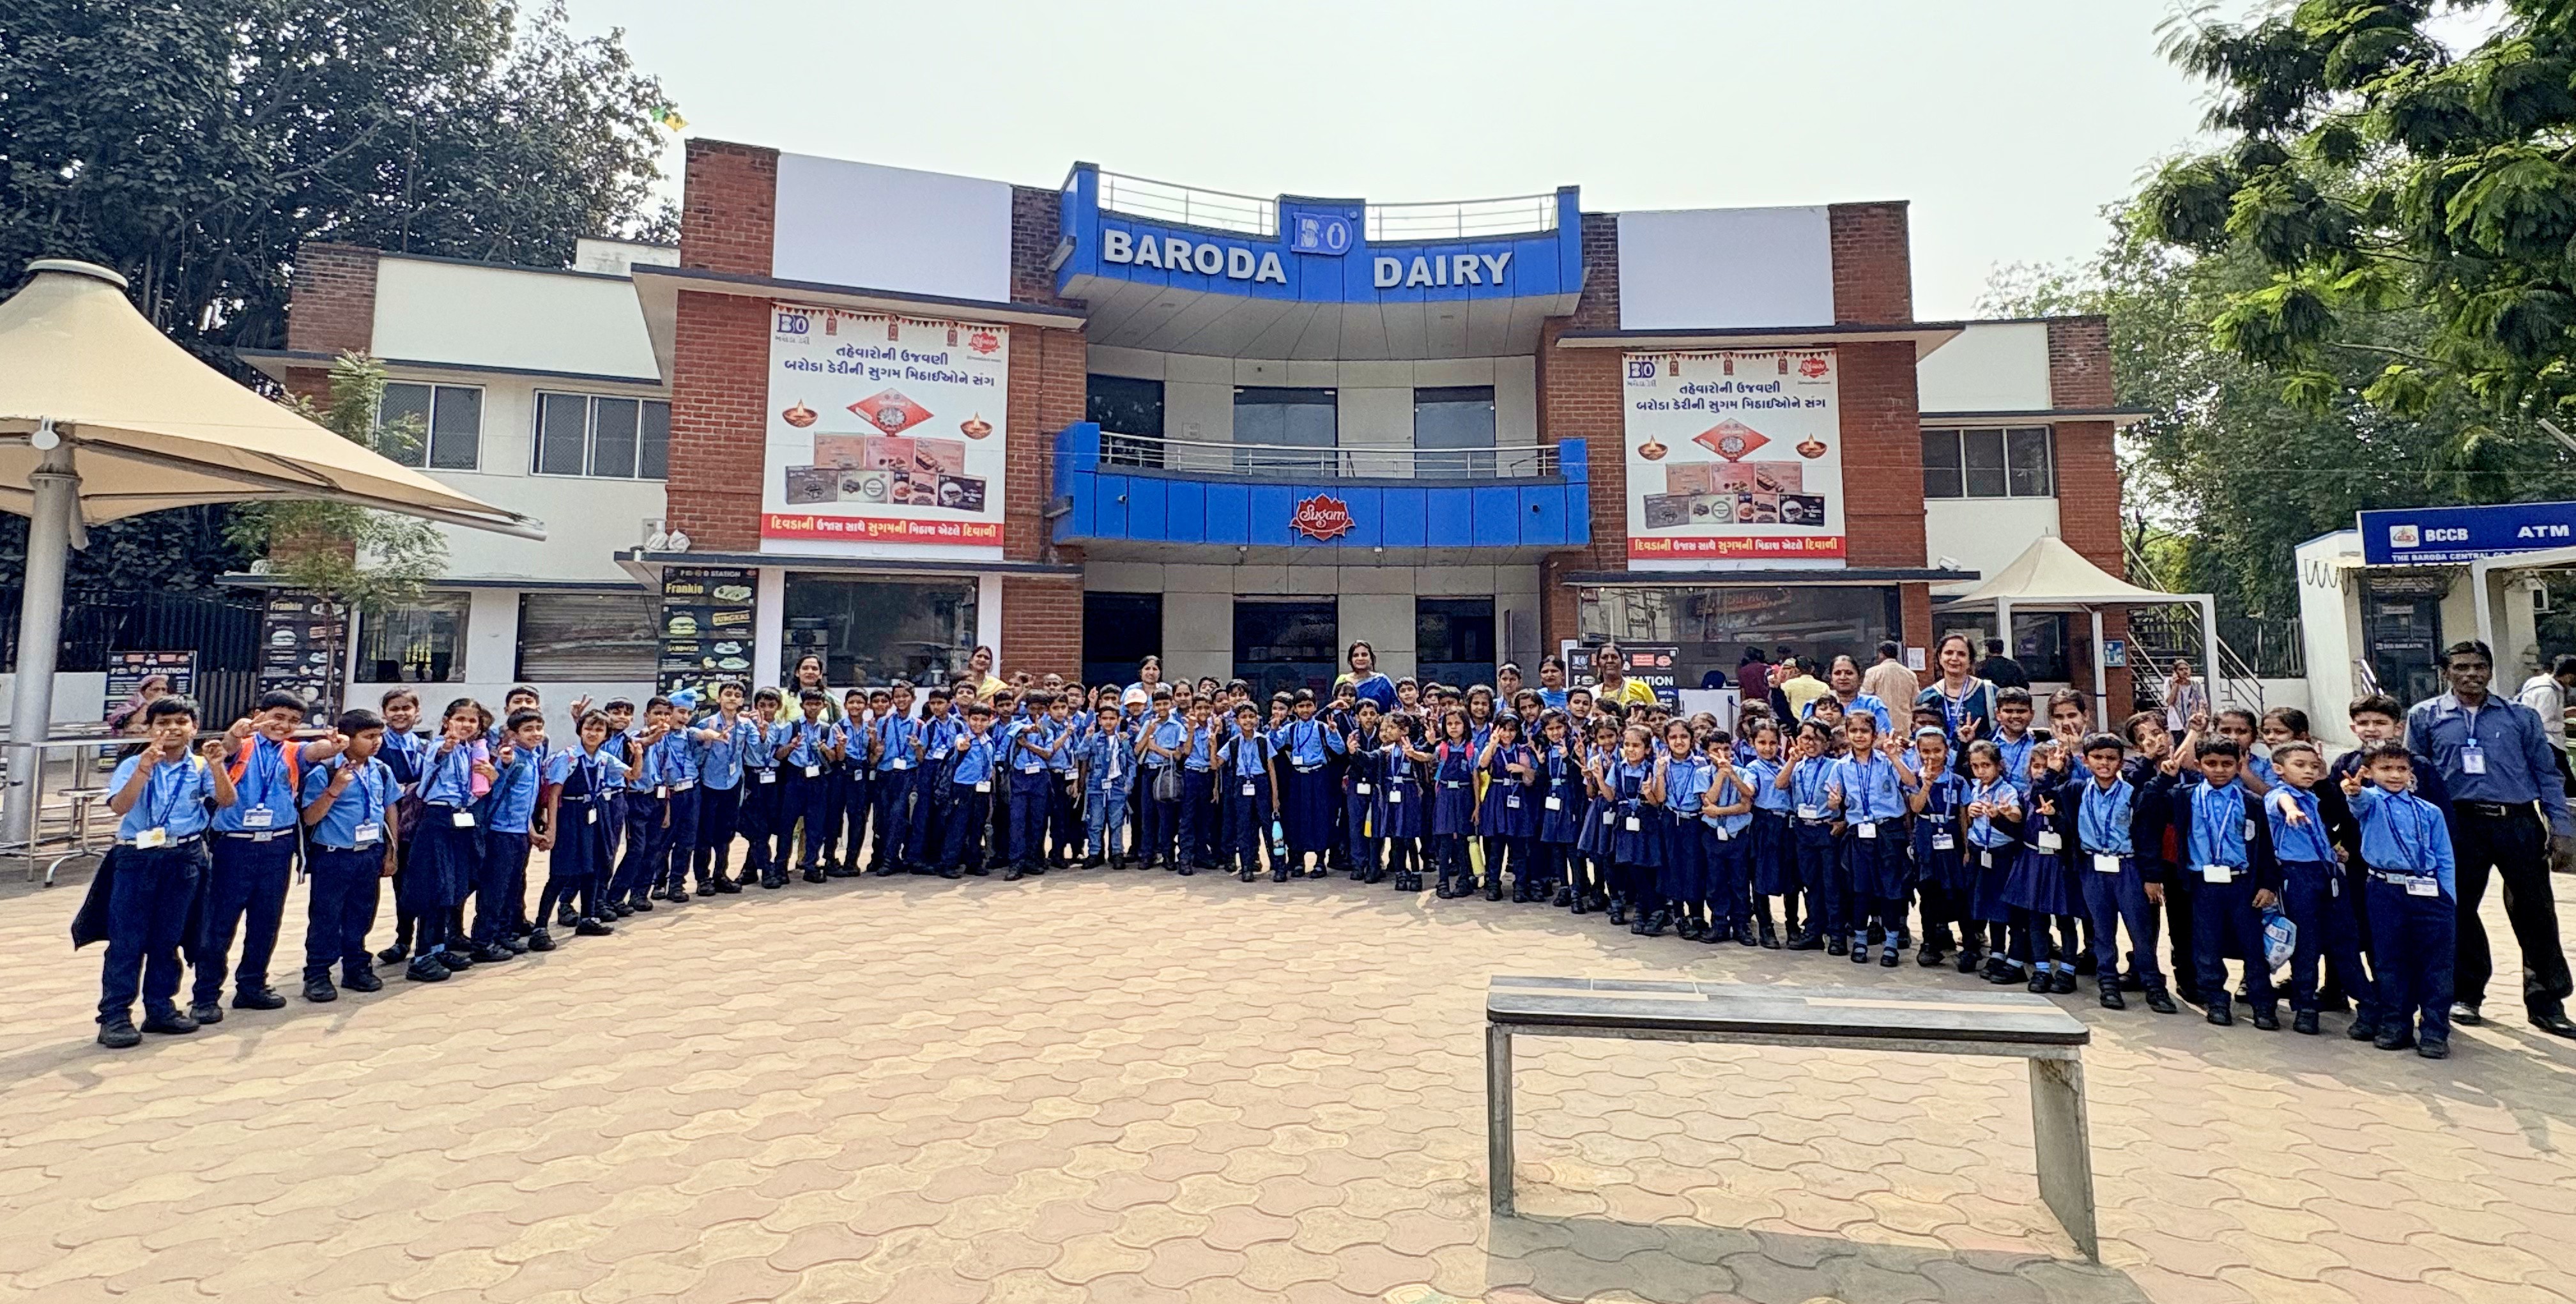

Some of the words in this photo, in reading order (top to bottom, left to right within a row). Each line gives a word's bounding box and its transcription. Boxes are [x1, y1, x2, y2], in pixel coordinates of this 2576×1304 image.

[1103, 228, 1287, 284] BARODA
[1374, 251, 1514, 288] DAIRY
[836, 343, 896, 361] તહેવારોની
[901, 349, 948, 365] ઉજવણી
[785, 357, 823, 372] બરોડા
[827, 360, 864, 376] ડેરીની
[868, 367, 901, 381] સુગમ
[906, 366, 969, 385] મિઠાઈઓને
[973, 372, 995, 387] સંગ
[1680, 381, 1733, 395] તહેવારોની
[1737, 380, 1780, 394] ઉજવણી
[1636, 398, 1669, 410] બરોડા
[1672, 397, 1705, 410] ડેરીની
[1709, 401, 1738, 413] સુગમ
[1742, 395, 1800, 409] મિઠાઈઓને
[1805, 395, 1826, 408] સંગ
[1299, 504, 1346, 528] Sugam
[2425, 528, 2469, 542] BCCB
[2517, 525, 2570, 538] ATM
[2411, 553, 2447, 562] BARODA
[666, 583, 704, 594] Frankie
